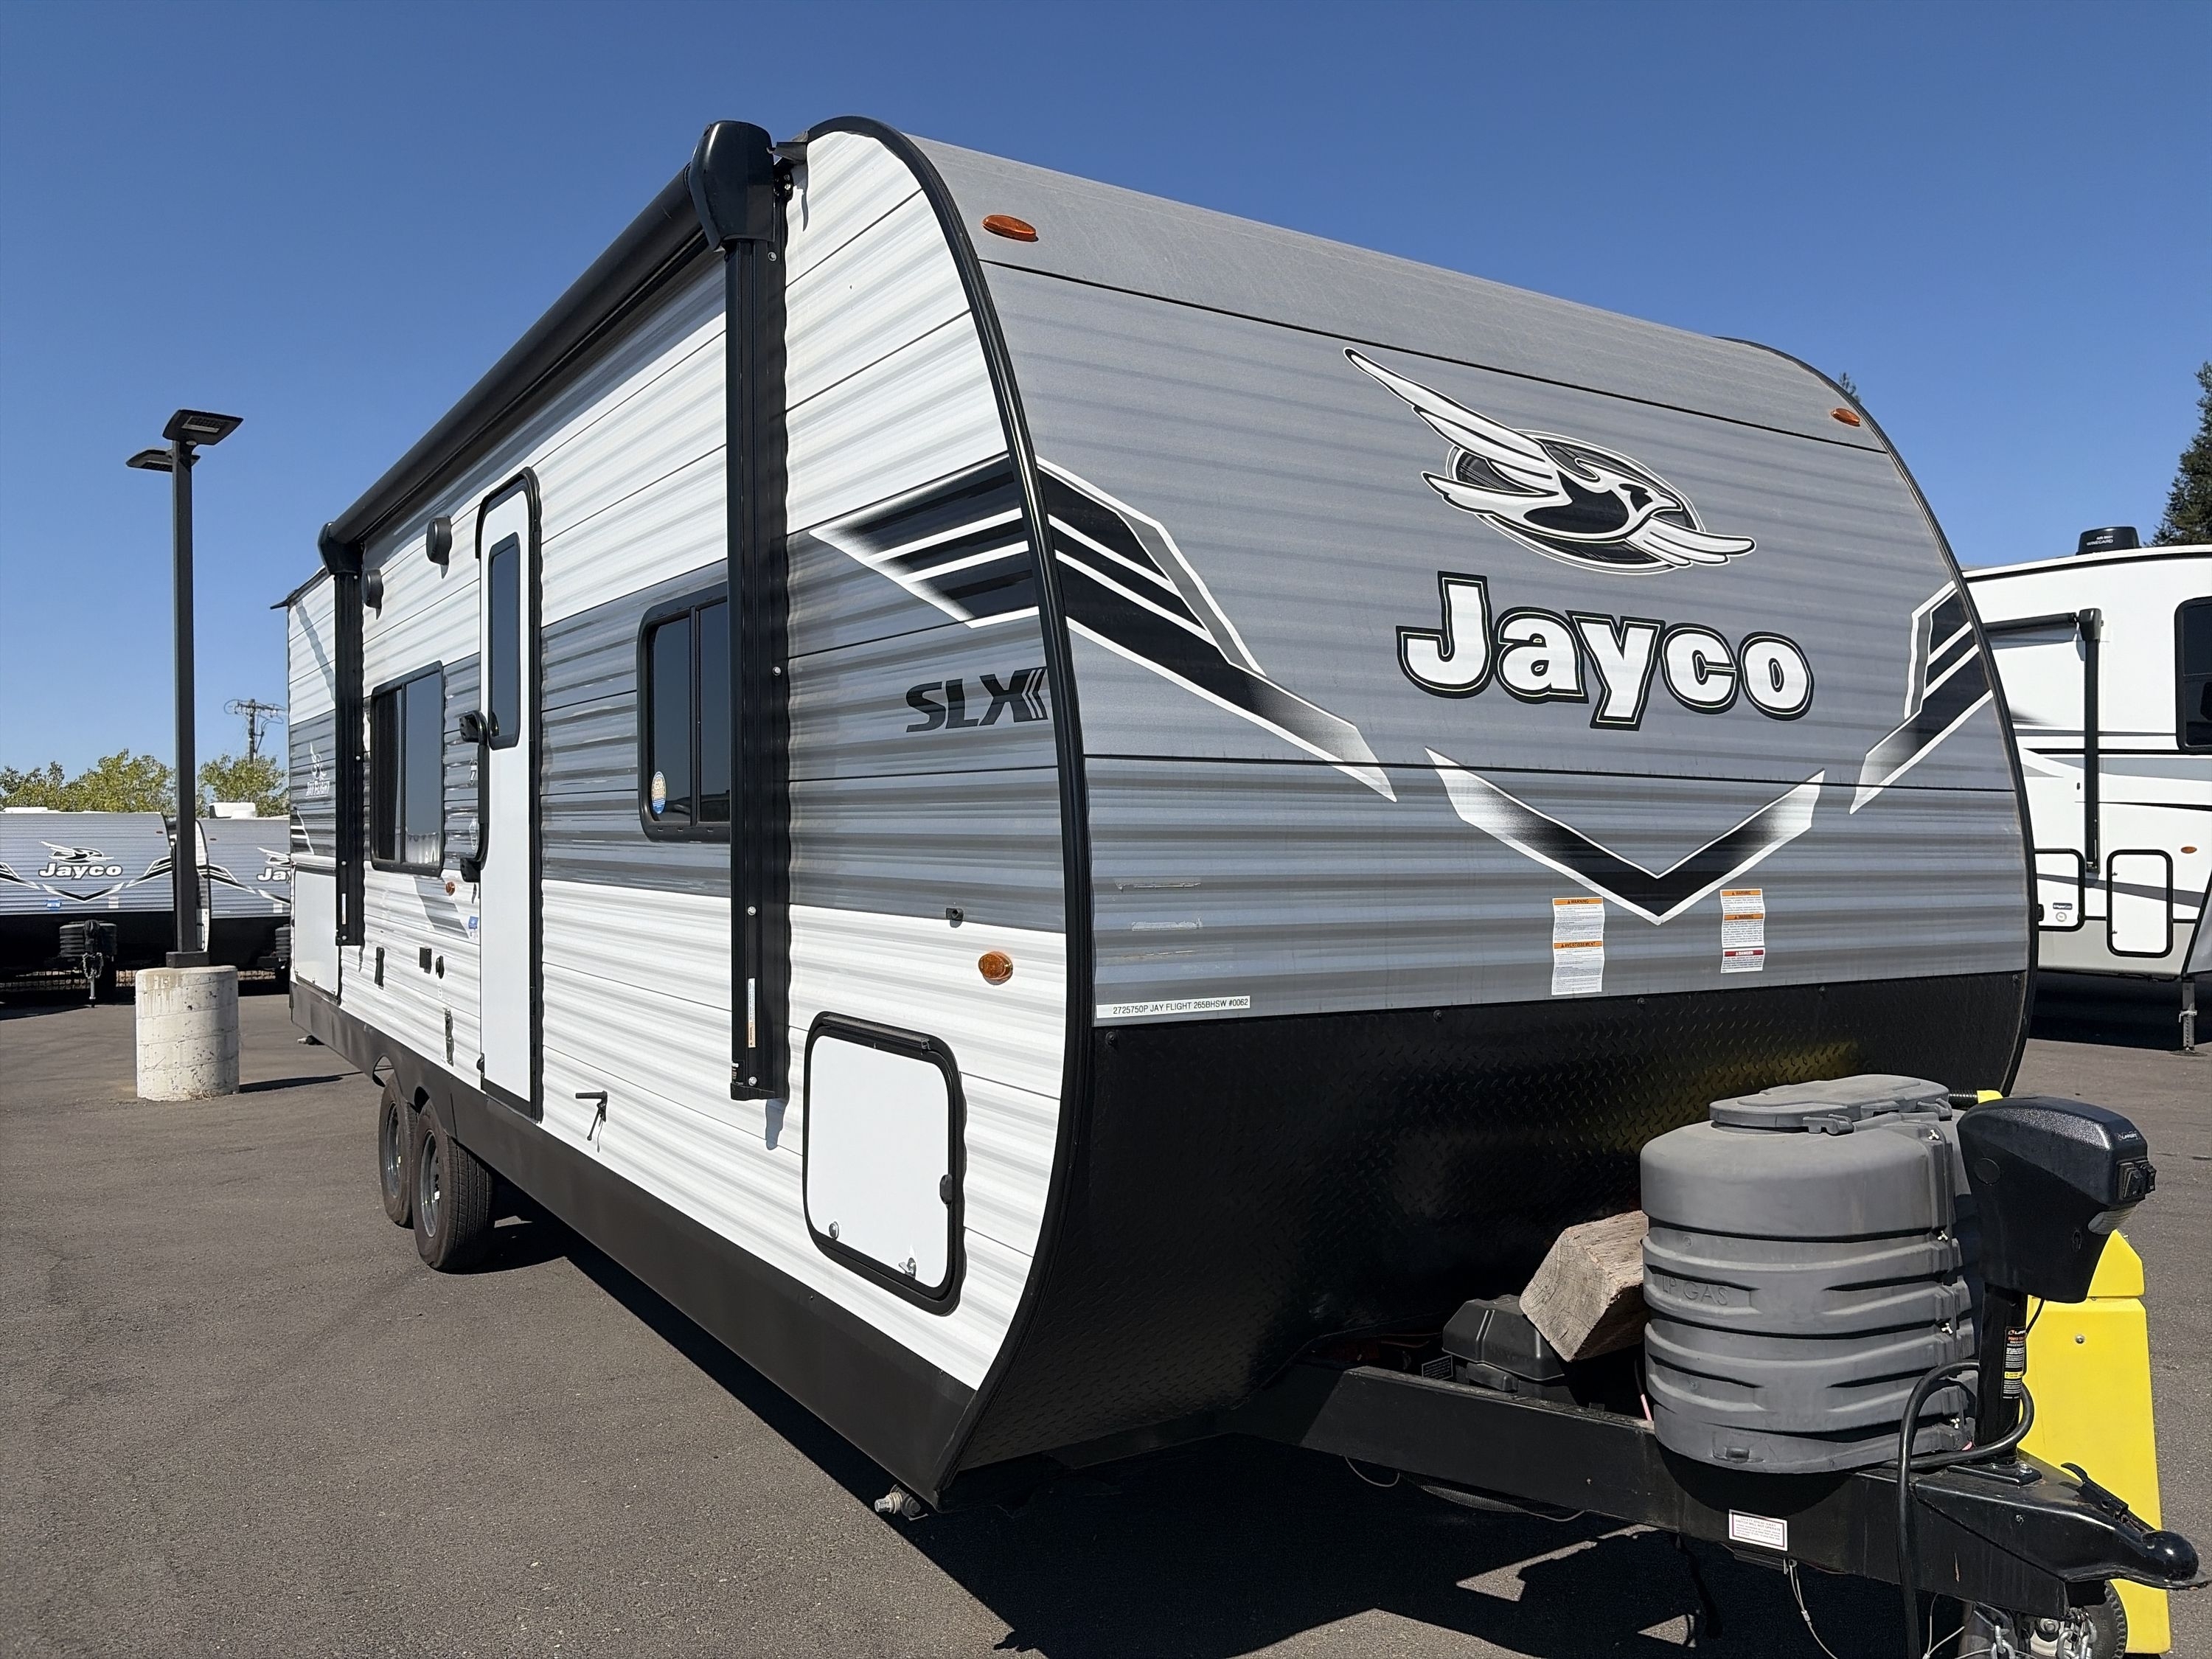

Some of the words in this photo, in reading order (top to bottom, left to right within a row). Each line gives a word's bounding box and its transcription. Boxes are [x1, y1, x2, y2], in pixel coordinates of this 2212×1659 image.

[1397, 571, 1814, 731] Jayco
[906, 666, 1048, 733] SLX
[38, 862, 123, 880] Jayco
[1113, 1005, 1148, 1014] 2725750P
[1150, 1004, 1164, 1012] JAY
[1166, 1002, 1192, 1011] FLIGHT
[1193, 1000, 1227, 1009] 265BHSW
[1228, 998, 1248, 1006] #0062
[1683, 1281, 1729, 1306] GAS
